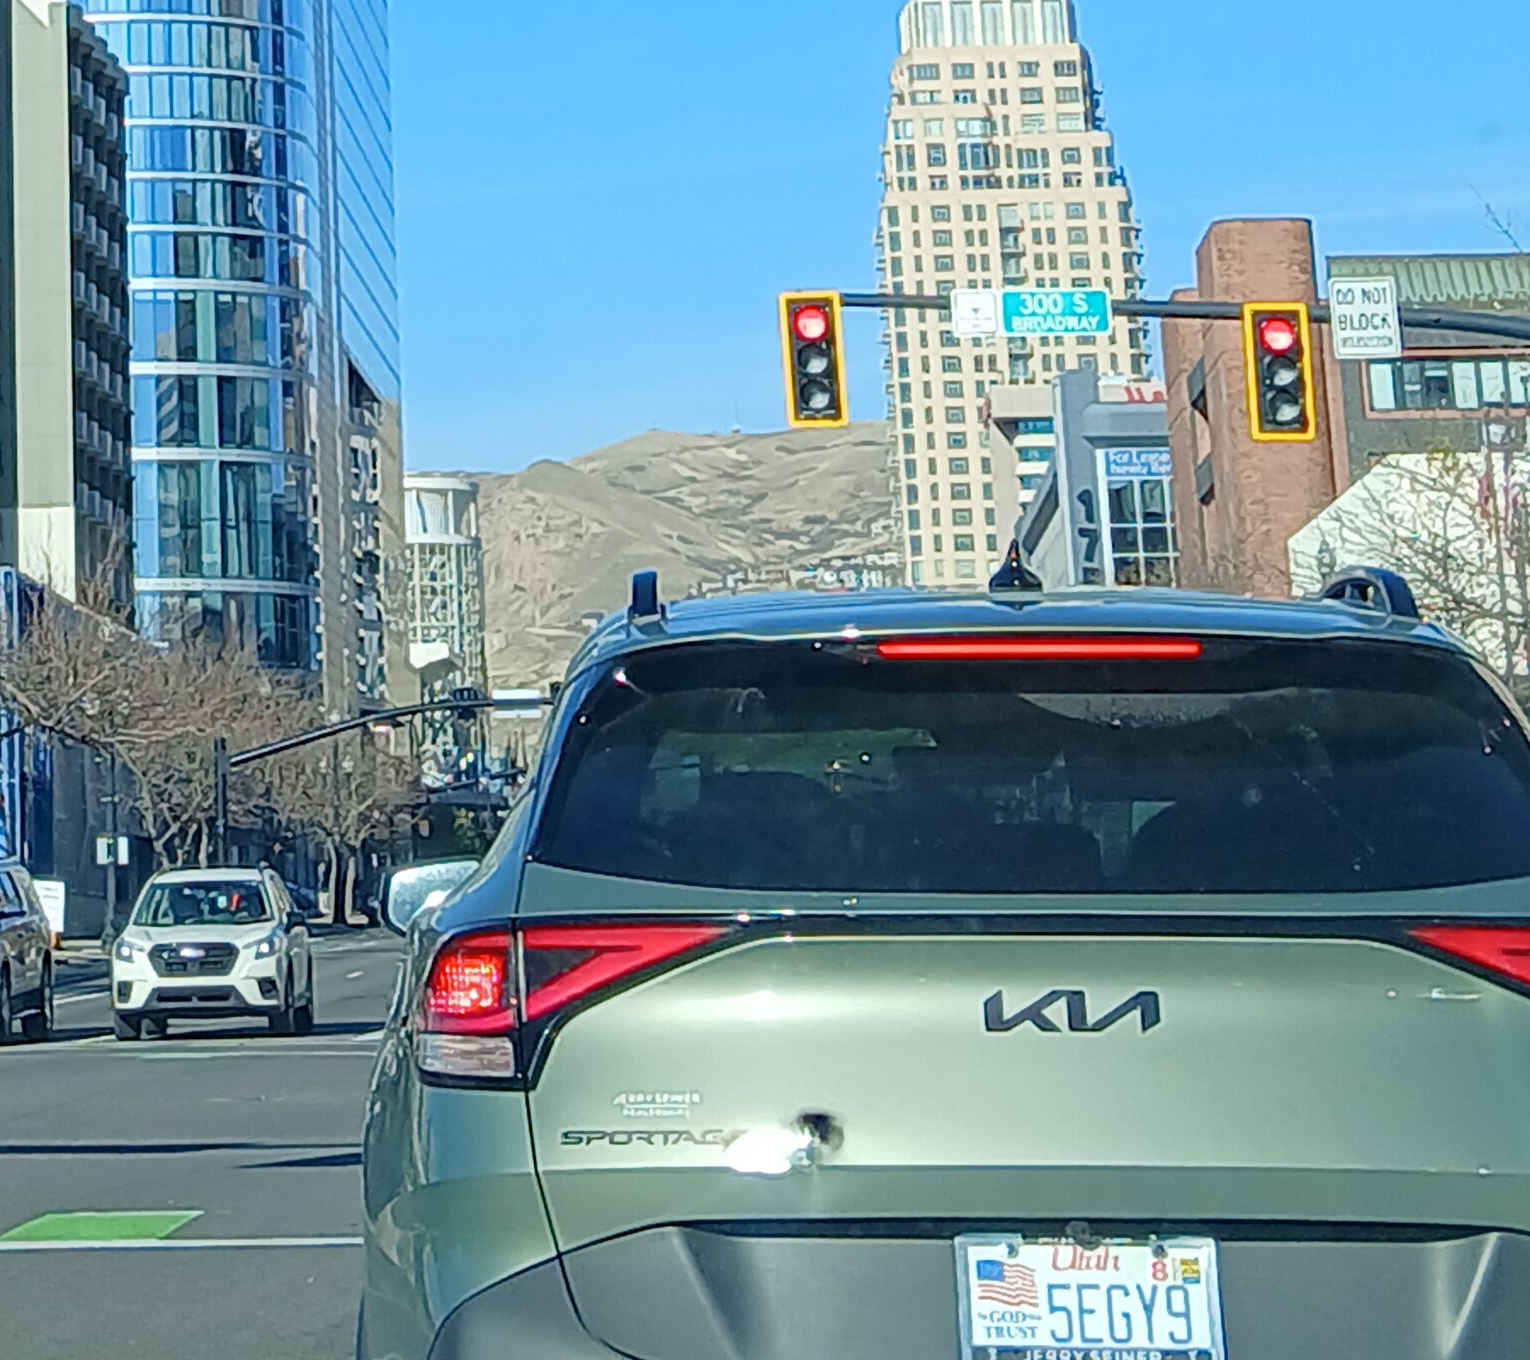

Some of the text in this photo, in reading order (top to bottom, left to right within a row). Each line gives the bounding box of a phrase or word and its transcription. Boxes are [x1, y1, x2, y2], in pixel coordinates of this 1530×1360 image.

[1019, 293, 1063, 315] 300
[1011, 315, 1101, 331] BROADWAY
[1337, 312, 1392, 331] BLOCK
[984, 990, 1160, 1033] KIA
[989, 1311, 1027, 1324] GOD
[1047, 1283, 1192, 1344] 5EGY9
[983, 1326, 1039, 1339] TRUST
